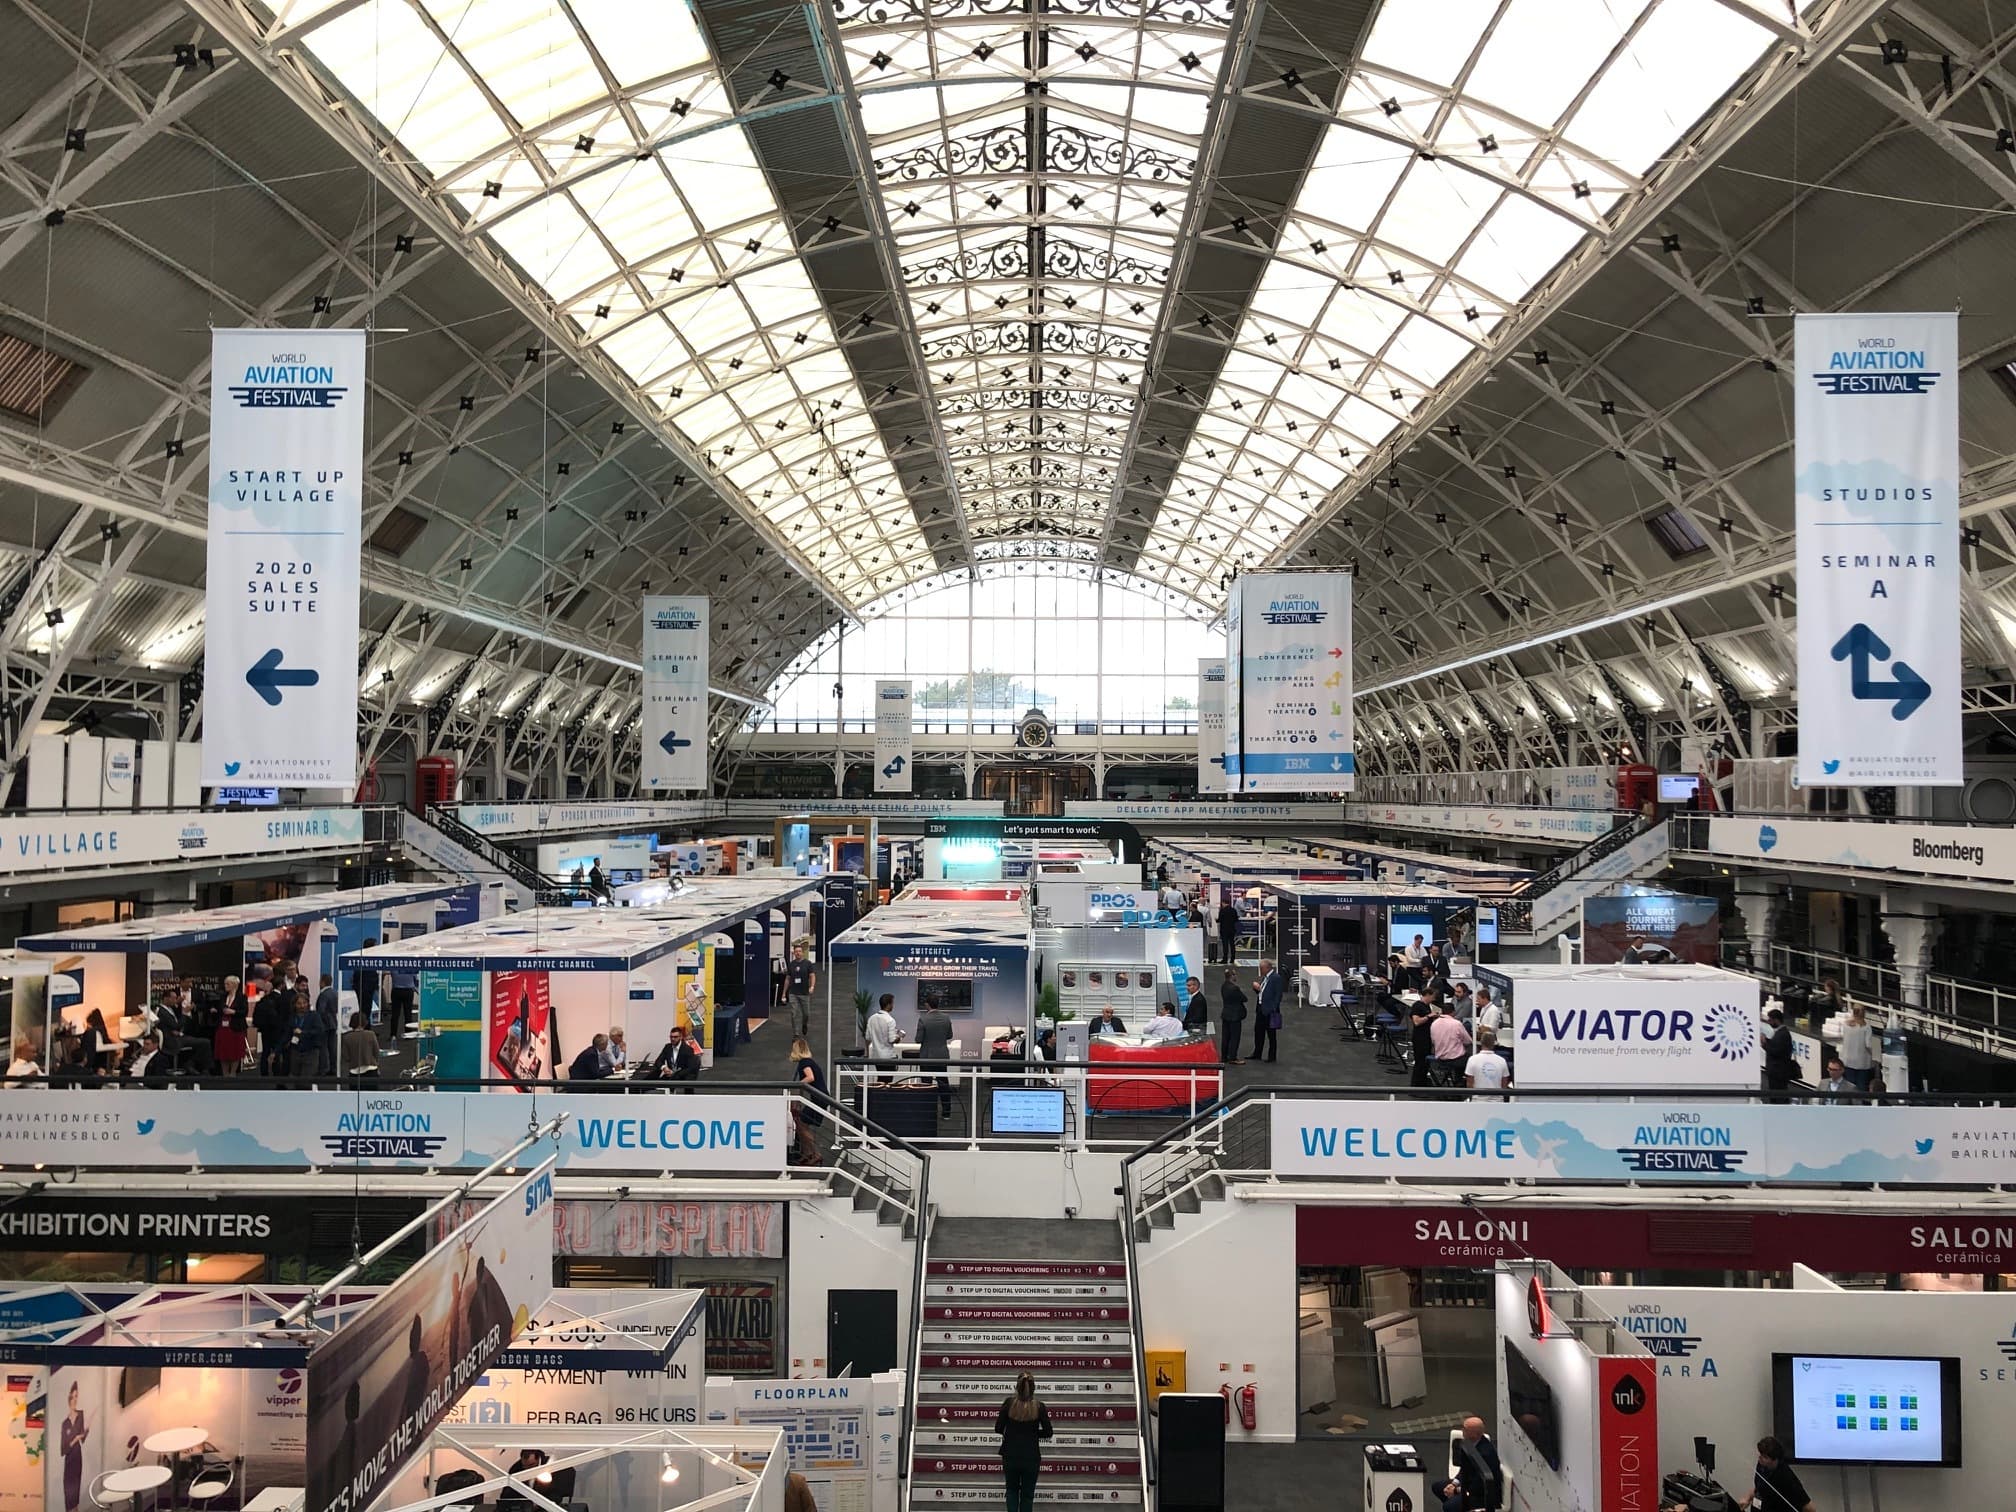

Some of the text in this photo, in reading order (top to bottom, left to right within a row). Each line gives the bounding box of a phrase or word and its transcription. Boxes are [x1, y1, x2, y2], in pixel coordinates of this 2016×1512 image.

[1858, 339, 1895, 348] WORLD
[272, 354, 306, 363] WORLD
[1829, 351, 1924, 369] AVIATION
[244, 366, 333, 384] AVIATION
[1840, 376, 1913, 391] FESTIVAL
[253, 389, 321, 405] FESTIVAL
[230, 471, 344, 483] START UP
[237, 490, 335, 502] VILLAGE
[1823, 488, 1933, 501] STUDIOS
[255, 562, 312, 574] 2020
[1821, 555, 1936, 568] SEMINAR
[248, 581, 319, 593] SALES
[1870, 580, 1888, 598] A
[249, 600, 317, 612] SUITE
[1269, 601, 1319, 611] AVIATION
[657, 612, 696, 620] AVIATION
[1274, 614, 1313, 623] FESTIVAL
[661, 621, 691, 629] FESTIVAL
[671, 665, 679, 674] B
[671, 706, 678, 715] C
[1284, 758, 1310, 770] IBM
[226, 789, 262, 798] FESTIVAL
[862, 804, 910, 812] MEETING
[1199, 807, 1247, 815] MEETING
[1251, 807, 1291, 815] POINTS
[480, 811, 508, 825] SEMINAR
[267, 820, 330, 838] SEMINAR B
[1004, 825, 1075, 835] Let's put smart to
[19, 831, 119, 855] VILLAGE
[1912, 838, 1984, 865] Bloomberg
[1400, 904, 1429, 912] INFARE
[1122, 909, 1190, 928] PROS
[348, 959, 383, 967] ATTACHED
[1520, 1009, 1694, 1041] AVIATOR
[1552, 1046, 1692, 1057] More revenue from every flight
[366, 1100, 403, 1111] WORLD
[337, 1113, 431, 1132] AVIATION
[1663, 1113, 1700, 1124] WORLD
[578, 1119, 765, 1149] WELCOME
[1635, 1126, 1731, 1146] AVIATION
[347, 1138, 418, 1155] FESTIVAL
[1301, 1128, 1515, 1159] WELCOME
[1645, 1151, 1719, 1169] FESTIVAL
[525, 1171, 553, 1217] SITA
[139, 1214, 271, 1237] PRINTERS
[619, 1203, 771, 1252] DISPLAY
[1415, 1220, 1528, 1242] SALONI
[1440, 1244, 1504, 1256] cerámica
[1936, 1250, 2001, 1263] cerámica
[1629, 1305, 1661, 1313] WORLD
[165, 1353, 233, 1364] VIPPER.COM
[535, 1355, 564, 1365] BAGS
[1701, 1358, 1718, 1377] A
[524, 1369, 607, 1384] PAYMENT
[754, 1387, 849, 1400] FLOORPLAN
[1615, 1393, 1641, 1405] ink
[266, 1394, 302, 1407] vipper
[352, 1451, 387, 1507] MOVE
[389, 1415, 413, 1463] THE
[453, 1323, 501, 1391] TOGETHER
[565, 1411, 602, 1424] BAG
[615, 1407, 635, 1422] 96
[978, 1464, 987, 1472] TO
